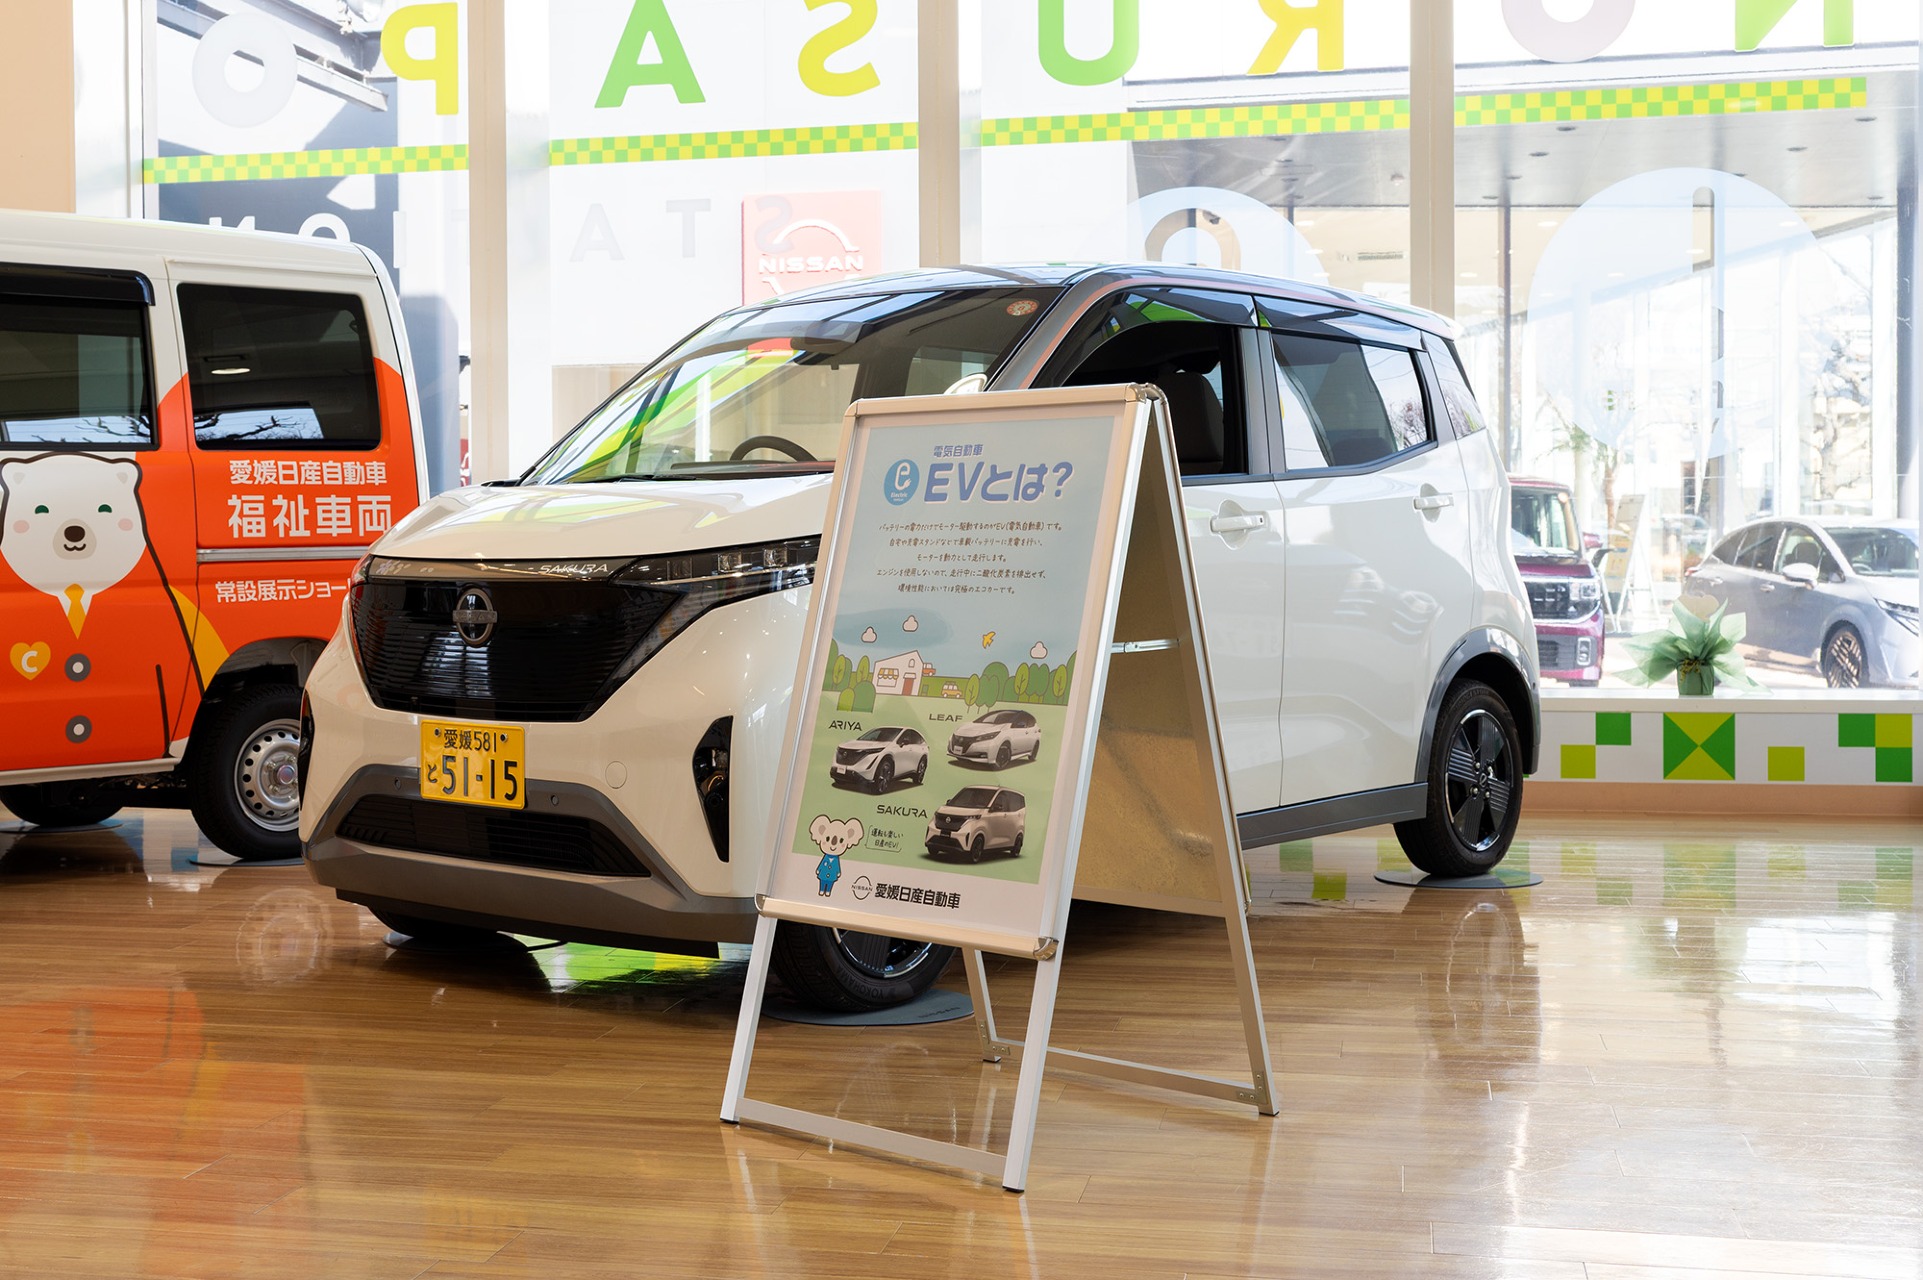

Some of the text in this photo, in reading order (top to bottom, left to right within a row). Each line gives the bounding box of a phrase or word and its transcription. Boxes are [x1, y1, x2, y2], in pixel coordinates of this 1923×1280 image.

[759, 254, 864, 273] NISSAN
[933, 443, 984, 458] 電気自動車
[229, 459, 388, 486] 愛媛日産自動車
[923, 461, 1075, 504] EVとは?
[227, 494, 392, 538] 福祉車両
[917, 552, 1007, 563] モーターを動力として走行します。
[540, 562, 609, 574] SAKURA
[215, 578, 351, 603] 常設展示ショー
[897, 583, 1015, 595] 環境性能においては究極のエコカーです。
[21, 650, 39, 673] C
[828, 720, 862, 731] ARIYA
[929, 713, 963, 722] LEAF
[427, 754, 518, 801] と 51-15
[876, 804, 928, 818] SAKURA
[851, 883, 961, 909] NISSAN 愛媛日産自動車
